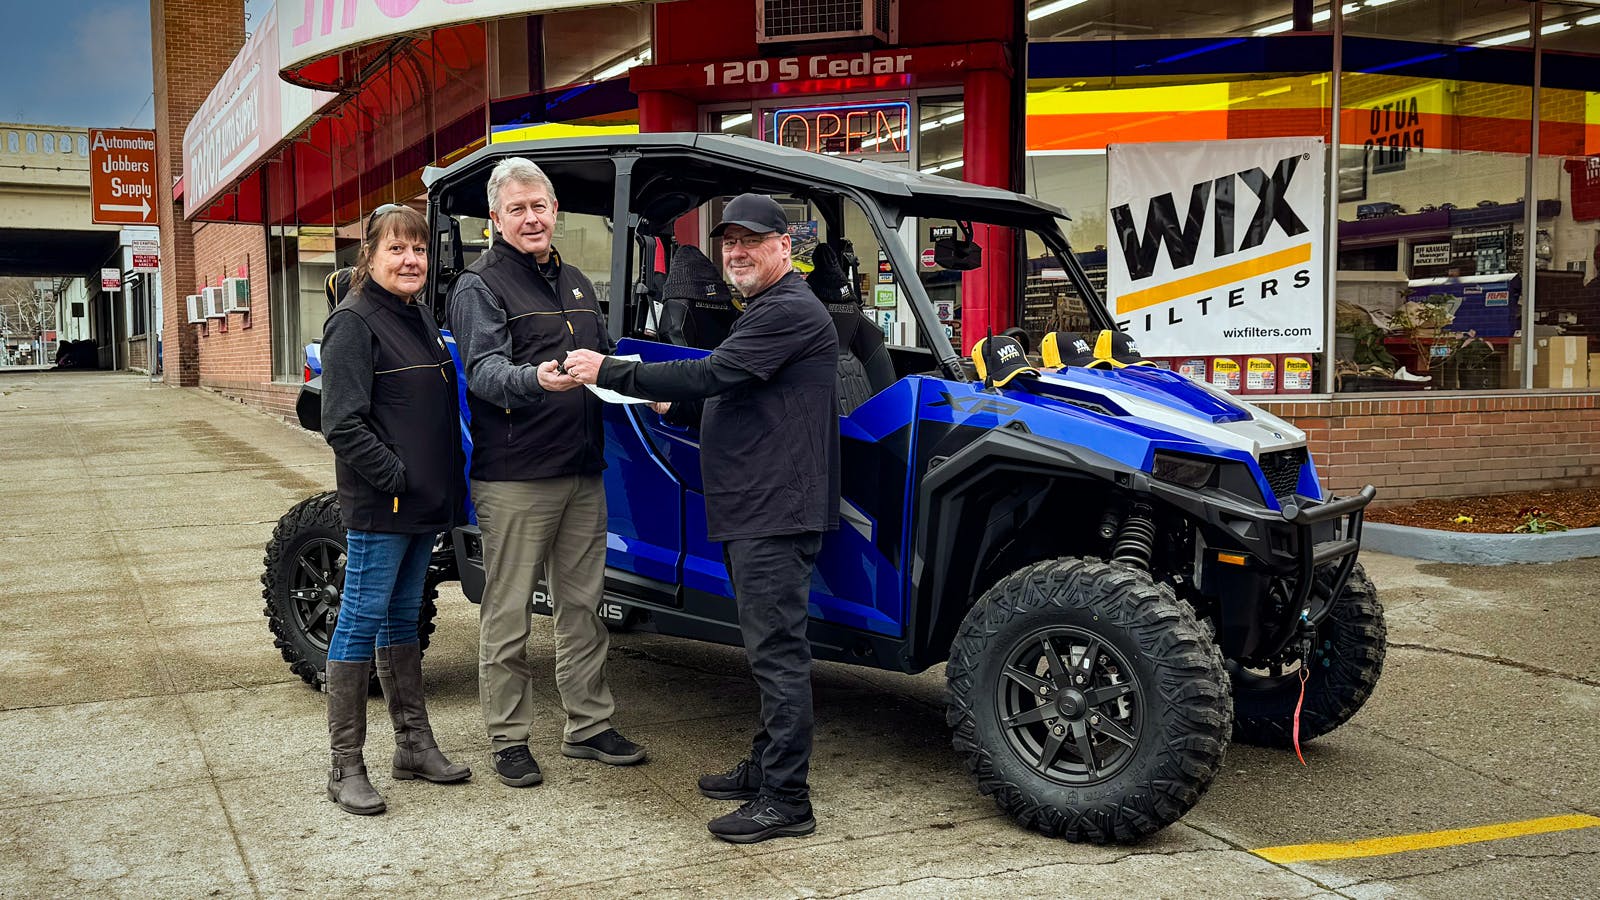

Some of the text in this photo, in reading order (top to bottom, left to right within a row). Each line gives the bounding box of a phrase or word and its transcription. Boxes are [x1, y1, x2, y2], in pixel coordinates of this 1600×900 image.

[703, 60, 769, 86] 120
[779, 57, 799, 81] S
[809, 52, 913, 78] Cedar
[236, 85, 259, 147] SUPPLY
[92, 131, 154, 151] Automotive
[779, 108, 905, 154] OPEN
[102, 154, 149, 174] Jobbers
[111, 177, 152, 198] Supply
[1110, 154, 1310, 281] WIX
[1117, 269, 1310, 332] FILTERS
[1223, 327, 1312, 338] wixfilters.com
[997, 344, 1016, 357] WIX
[1216, 361, 1237, 369] Prestone
[1250, 361, 1272, 369] Prestone
[1287, 361, 1308, 369] Prestone
[927, 391, 1022, 416] XP
